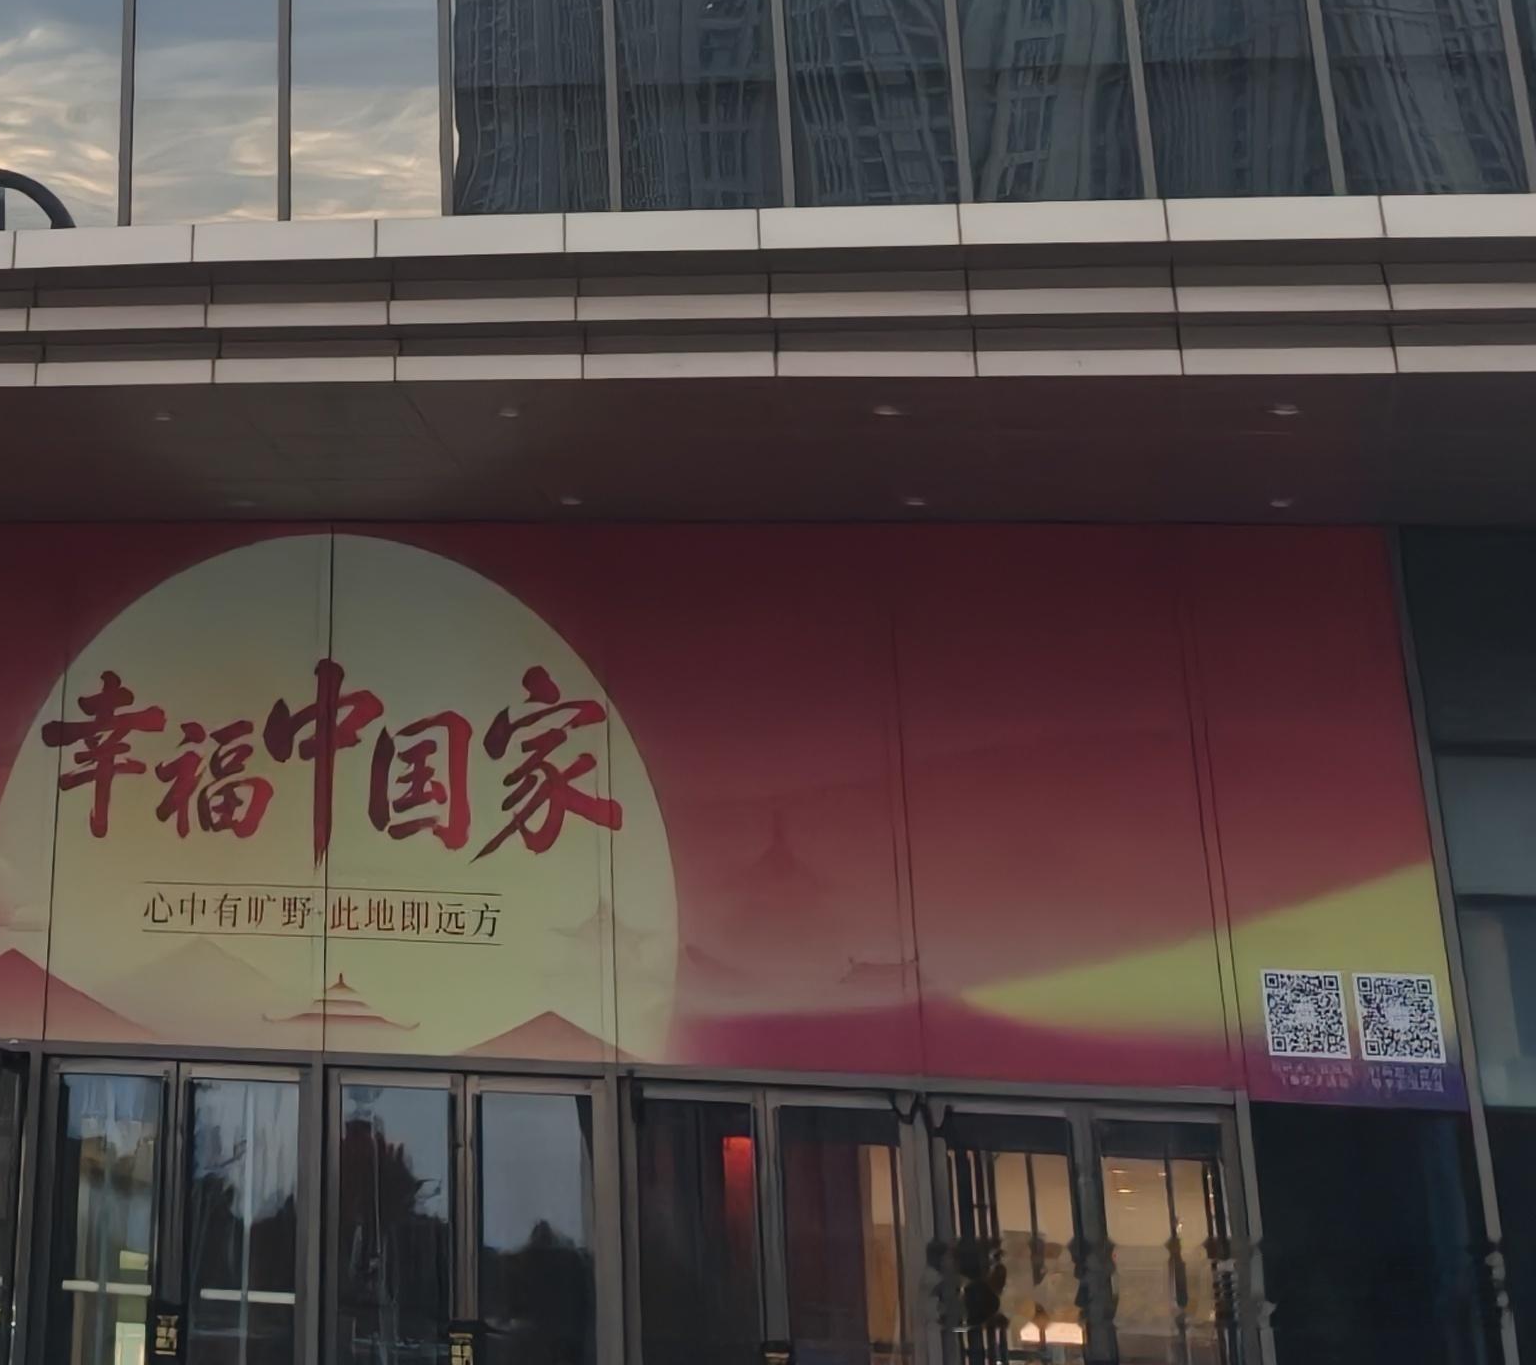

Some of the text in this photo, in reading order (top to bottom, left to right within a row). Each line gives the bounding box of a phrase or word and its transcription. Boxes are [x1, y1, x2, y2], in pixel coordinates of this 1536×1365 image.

[41, 657, 623, 869] 幸福中国家
